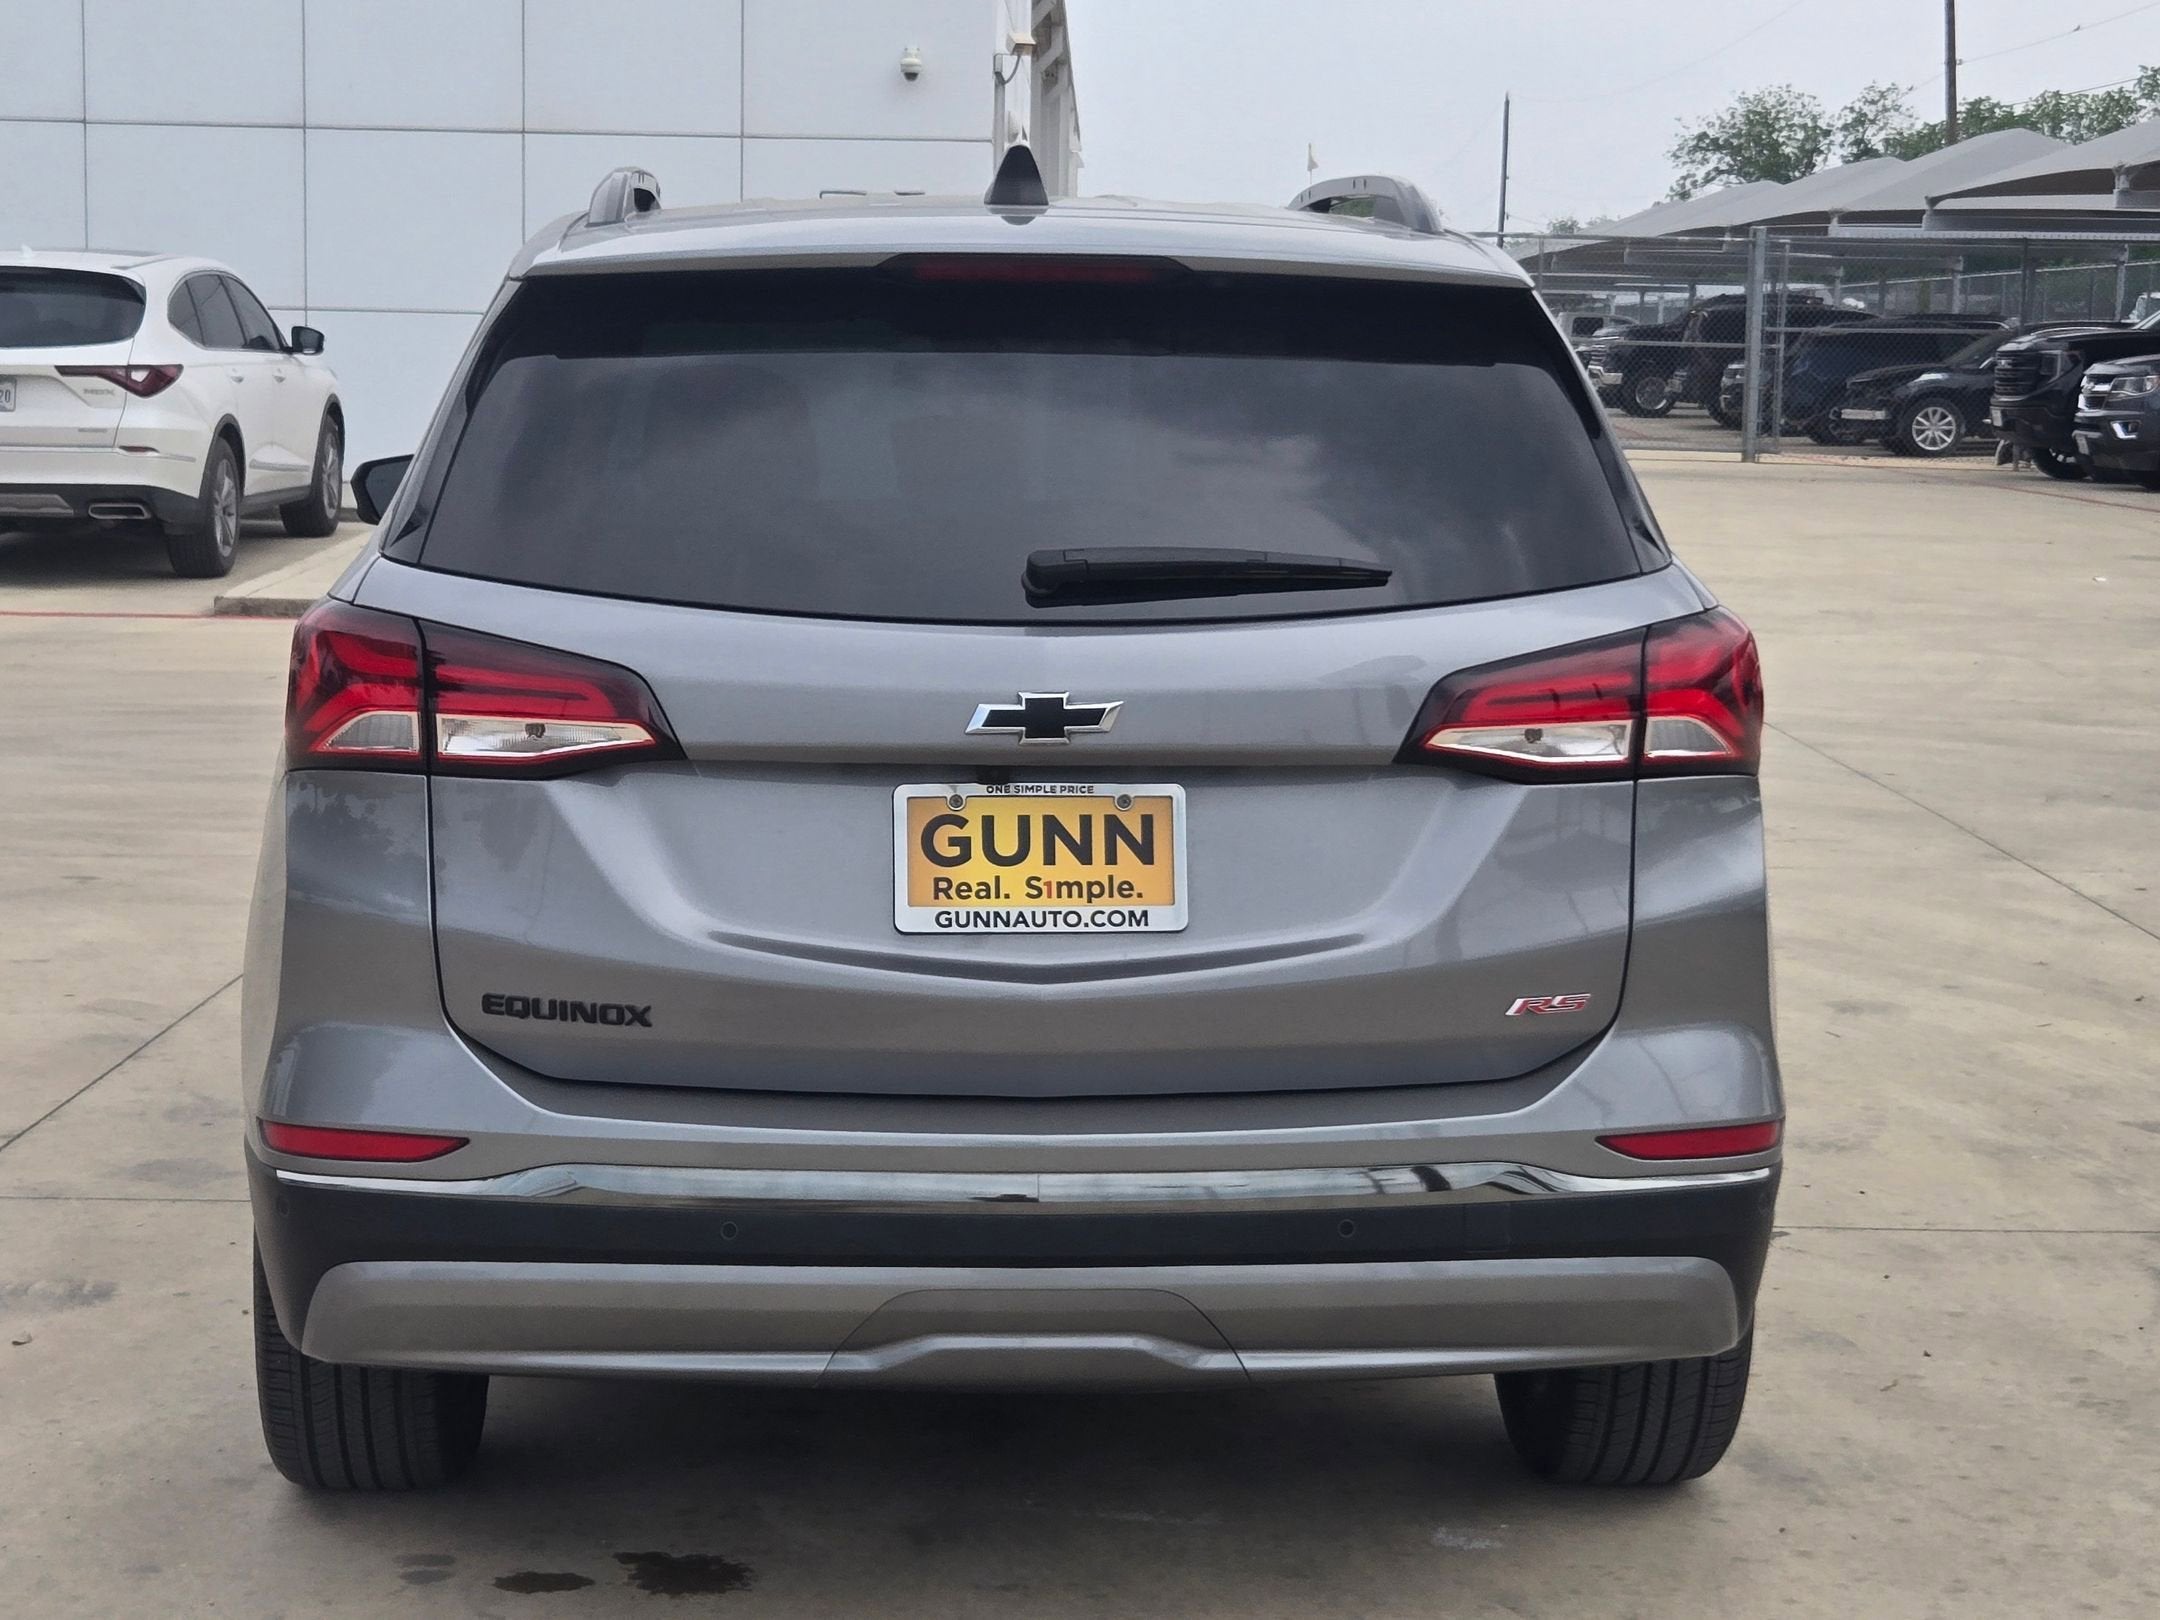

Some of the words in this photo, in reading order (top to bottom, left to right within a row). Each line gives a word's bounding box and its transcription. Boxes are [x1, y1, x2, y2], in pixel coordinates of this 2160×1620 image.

[986, 785, 1011, 794] ONE
[1014, 785, 1057, 794] SIMPLE
[1059, 785, 1095, 794] PRICE
[920, 813, 1155, 868] GUNN
[932, 876, 1011, 900] Real.
[934, 909, 1150, 930] GUNNAUTO.COM
[481, 992, 653, 1028] EQUINOX
[1504, 993, 1592, 1016] RS
